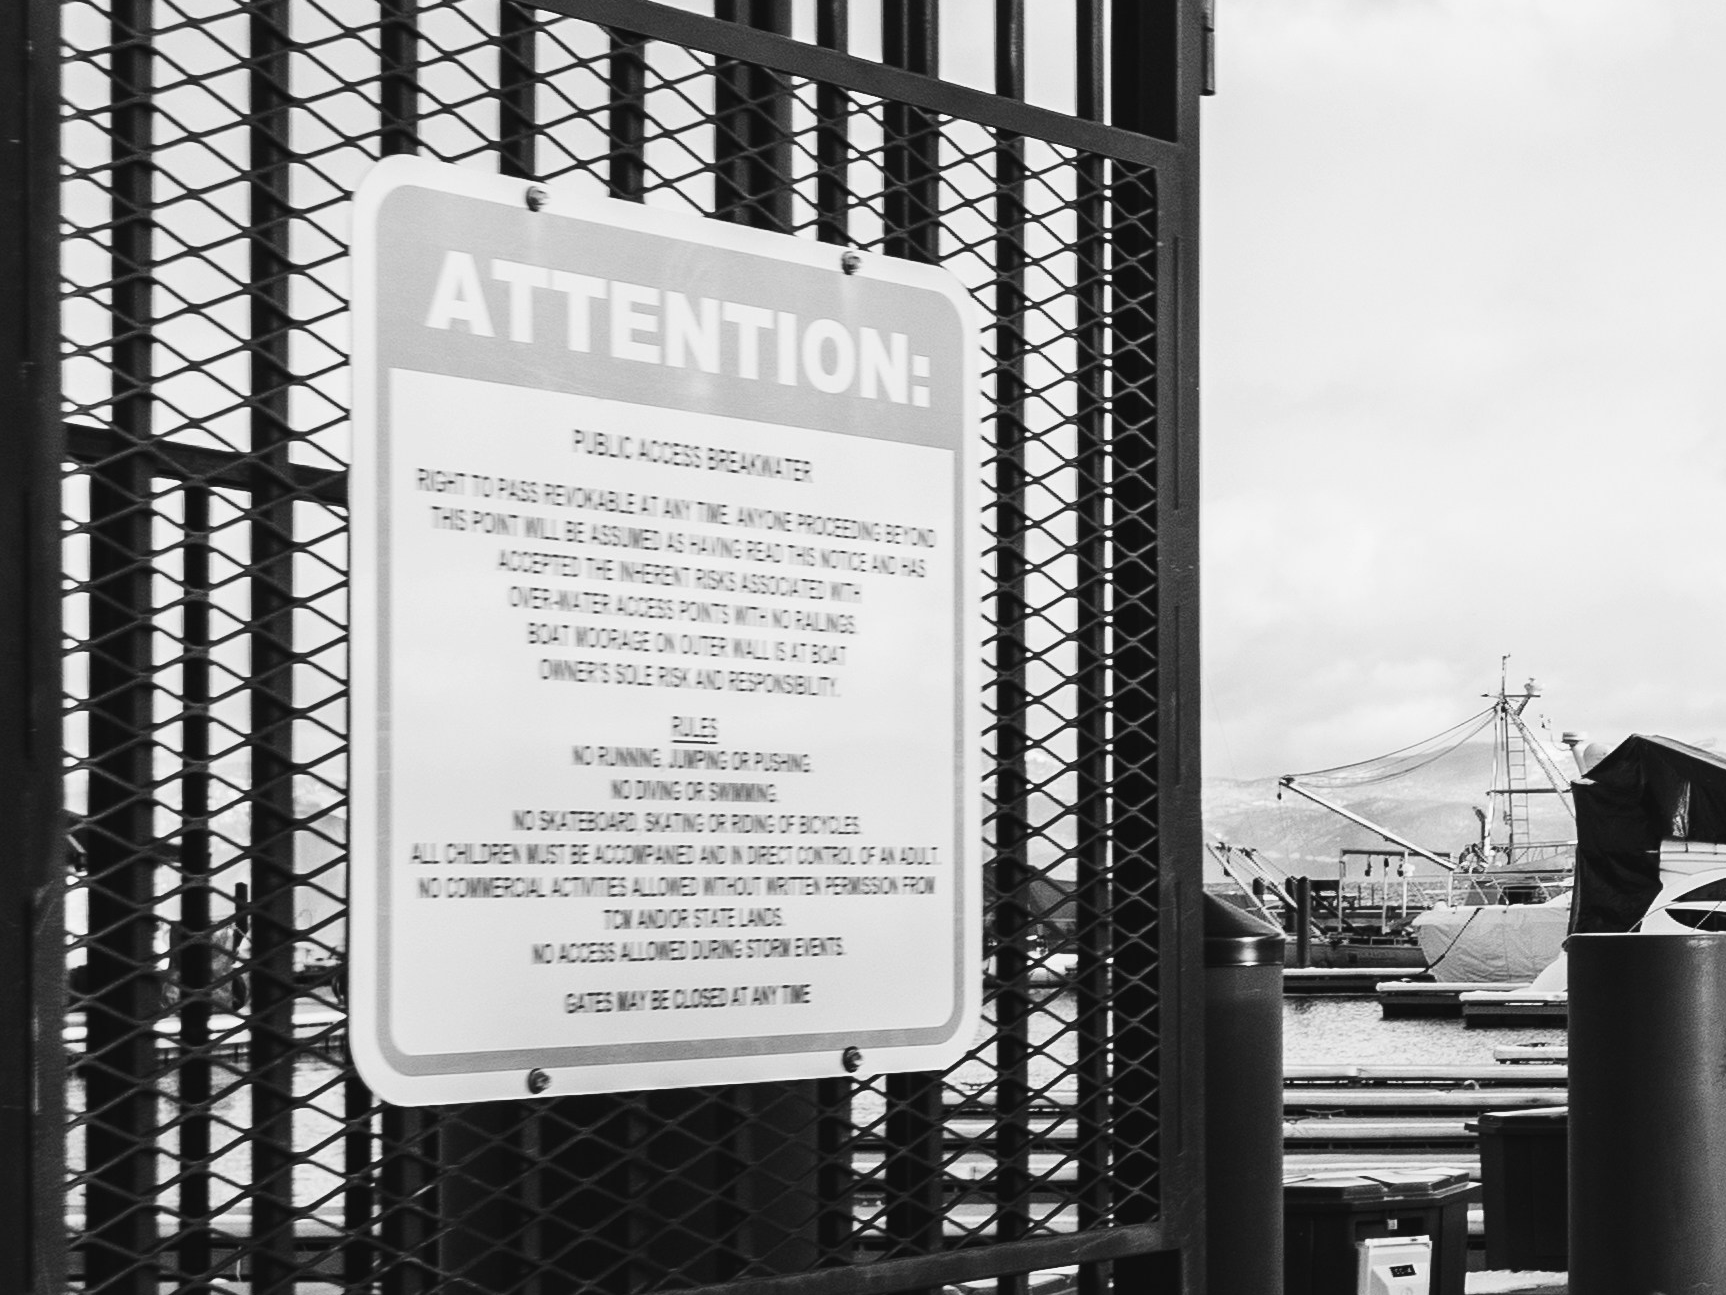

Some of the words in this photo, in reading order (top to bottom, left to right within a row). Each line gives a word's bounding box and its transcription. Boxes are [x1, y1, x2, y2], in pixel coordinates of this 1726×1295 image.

[425, 250, 931, 407] ATTENTION:
[573, 428, 632, 460] PUBLIC
[637, 437, 702, 469] ACCESS
[706, 446, 812, 483] BREAKWATER
[416, 467, 467, 496] RIGHT
[470, 473, 492, 499] TO
[497, 476, 539, 504] PASS
[543, 482, 636, 515] REVOKABLE
[639, 493, 658, 518] AT
[662, 496, 690, 521] ANY
[736, 505, 793, 533] ANYONE
[796, 512, 881, 543] PROCEEDING
[884, 523, 935, 549] BEYOND
[430, 505, 467, 532] THIS
[471, 509, 519, 537] POINT
[524, 515, 561, 541] WILL
[565, 520, 586, 544] BE
[589, 522, 661, 552] ASSUMED
[665, 530, 684, 554] AS
[688, 533, 742, 560] HAVING
[746, 539, 782, 564] READ
[786, 544, 816, 567] THIS
[820, 547, 867, 573] NOTICE
[871, 553, 896, 576] AND
[900, 556, 925, 579] HAS
[671, 715, 718, 735] RULES
[531, 941, 554, 964] NO
[557, 940, 617, 964] ACCESS
[618, 939, 688, 962] ALLOWED
[690, 938, 743, 961] DURING
[745, 937, 791, 959] STORM
[563, 989, 614, 1014] GATES
[616, 988, 649, 1012] MAY
[648, 988, 671, 1011] BE
[671, 986, 729, 1010] CLOSED
[729, 985, 748, 1008] AT
[750, 984, 779, 1007] ANY
[779, 983, 812, 1006] TIME
